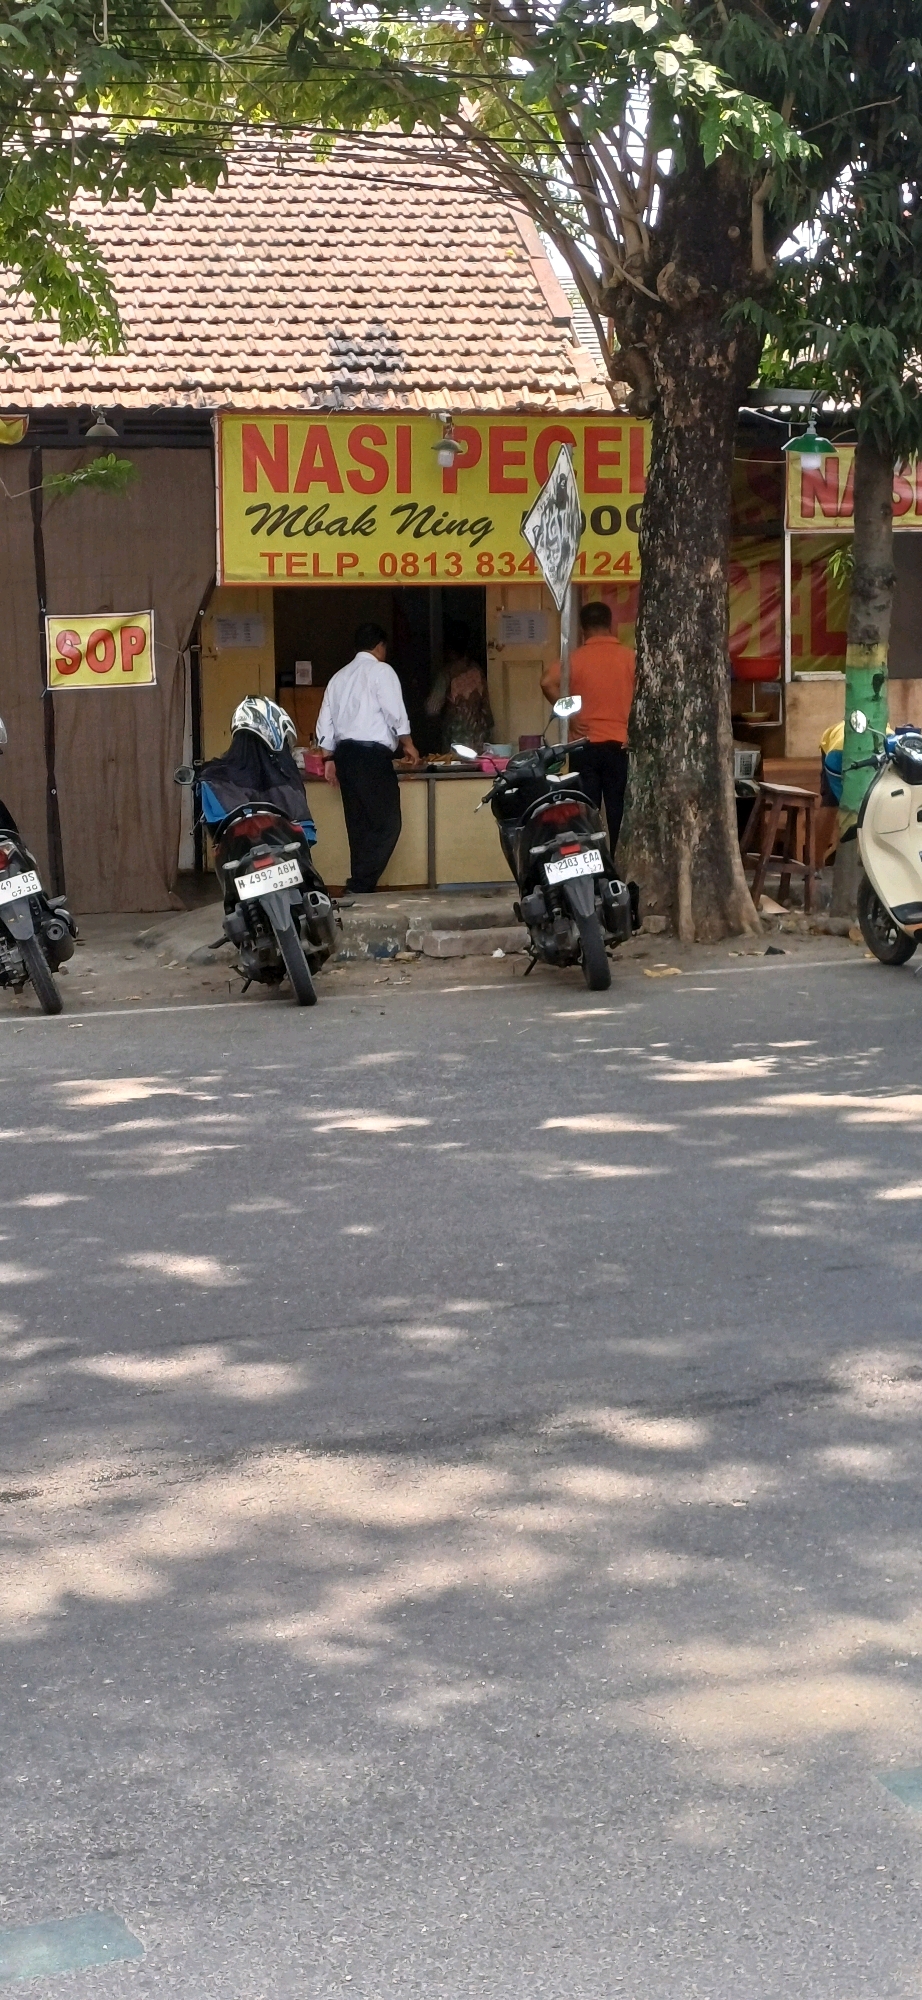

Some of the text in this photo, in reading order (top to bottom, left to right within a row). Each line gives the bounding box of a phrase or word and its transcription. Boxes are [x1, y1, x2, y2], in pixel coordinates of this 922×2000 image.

[241, 423, 411, 494] NASI
[244, 502, 378, 538] Mbak
[390, 502, 495, 548] Ning
[259, 550, 641, 577] TELP. 0813 834 124
[55, 625, 147, 675] SOP
[545, 863, 553, 874] K
